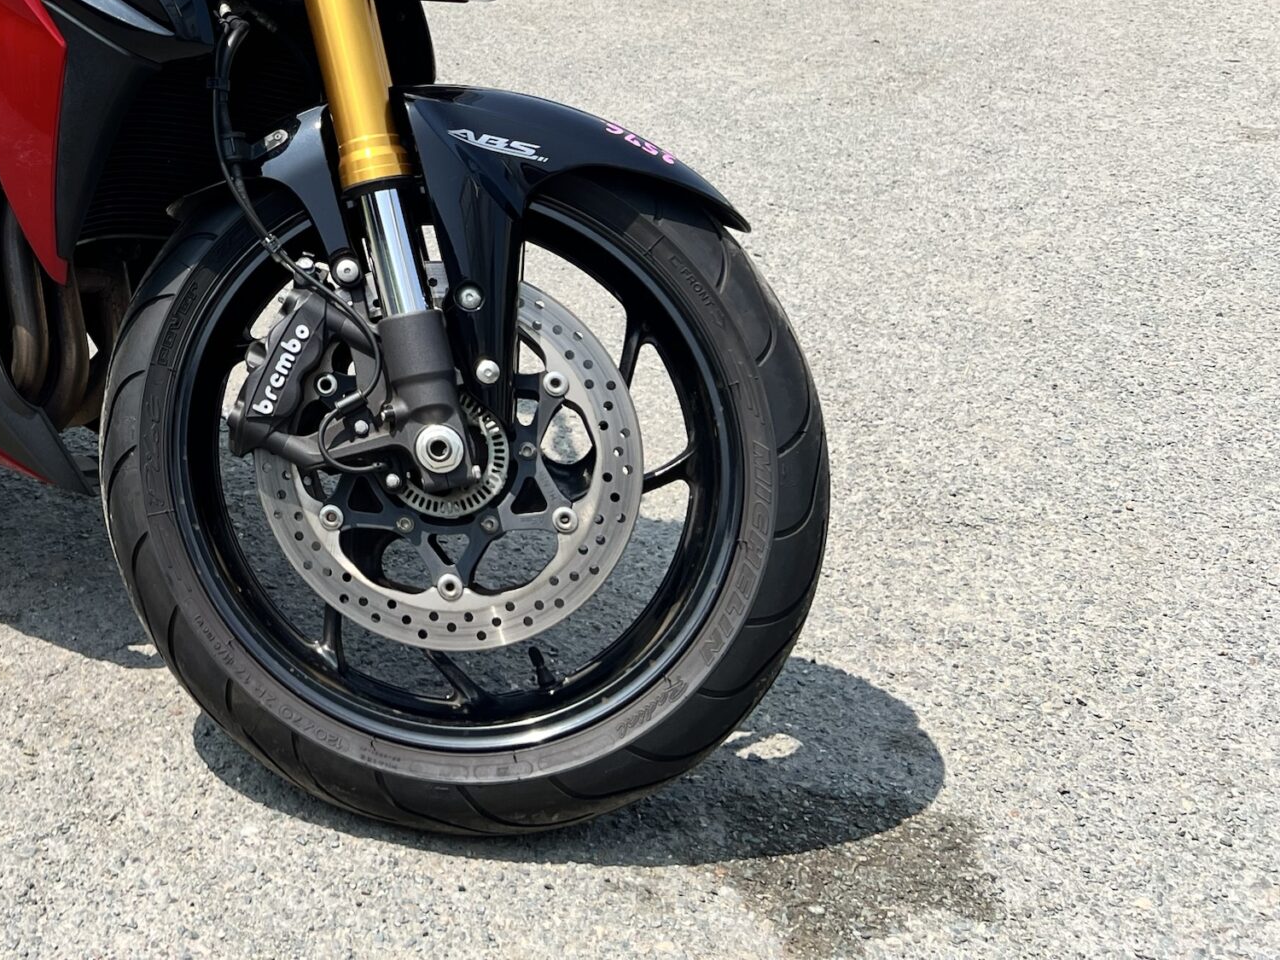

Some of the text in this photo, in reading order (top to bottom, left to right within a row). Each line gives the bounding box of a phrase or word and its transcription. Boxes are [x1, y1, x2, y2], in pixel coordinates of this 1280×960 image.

[447, 128, 542, 161] ABS
[252, 324, 310, 415] brembo
[699, 439, 771, 667] MICHELIN
